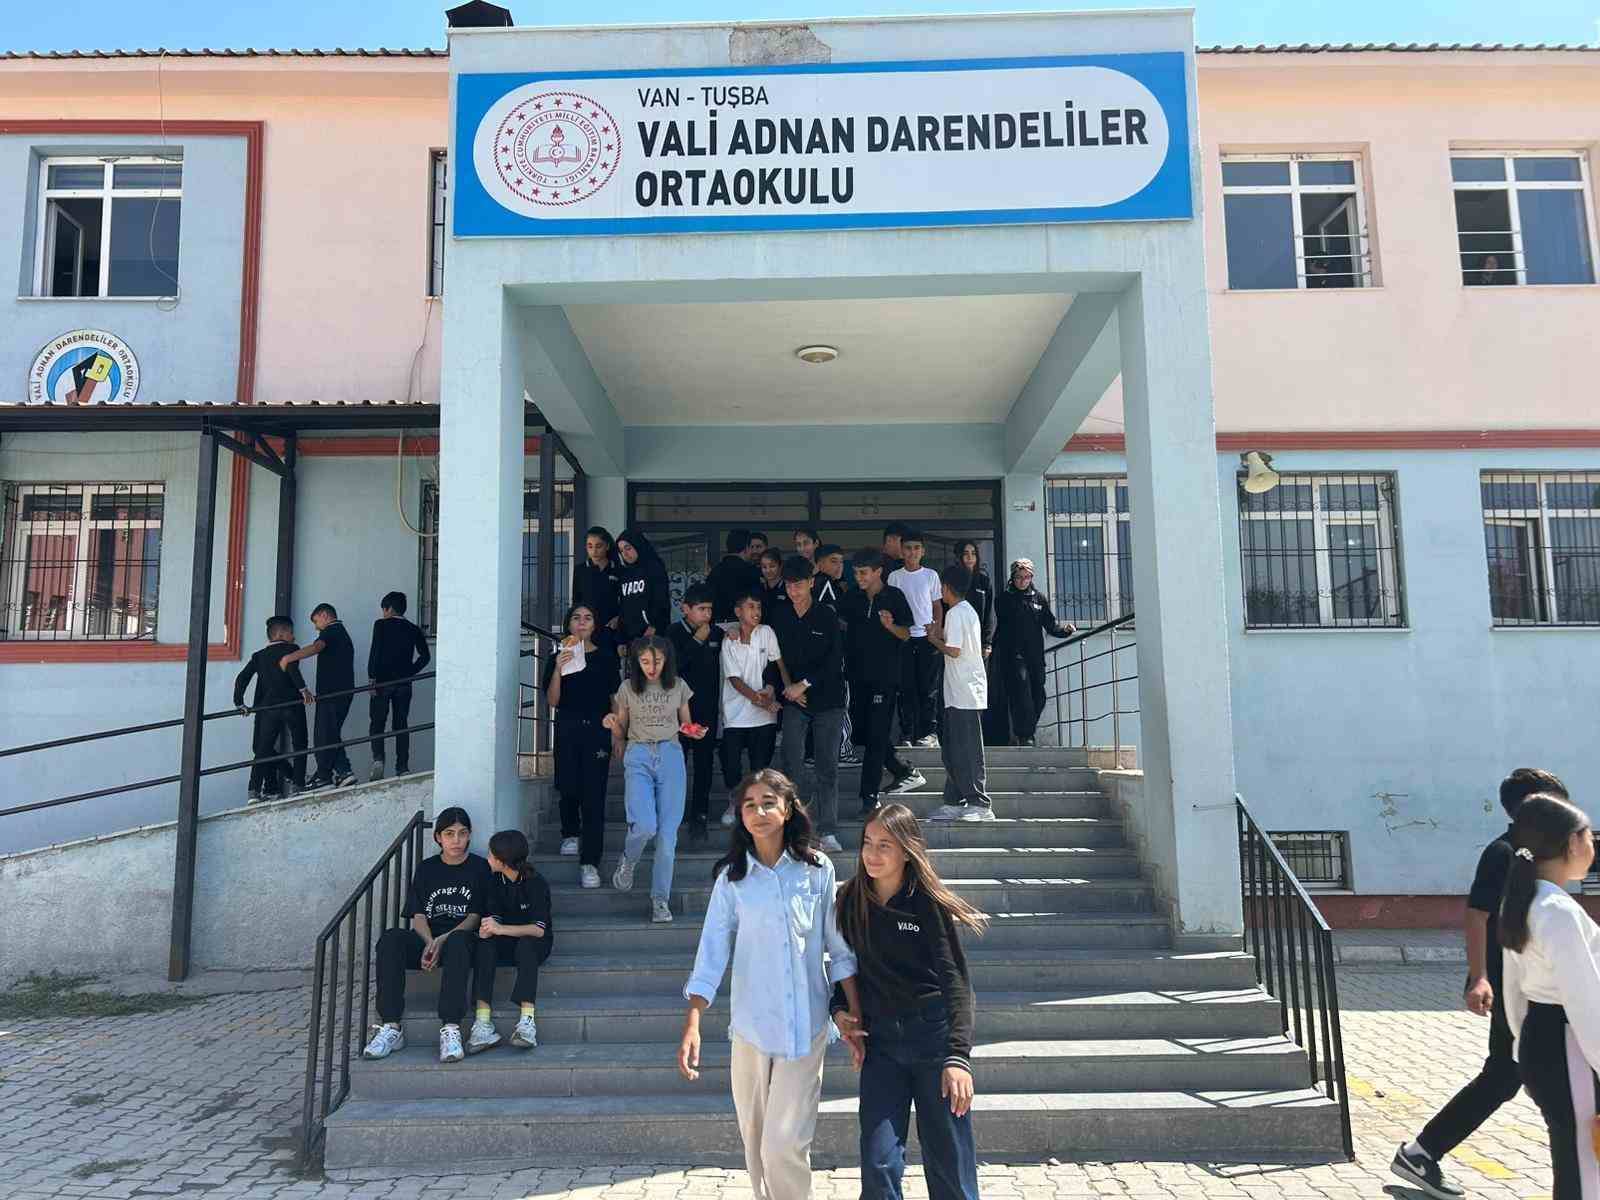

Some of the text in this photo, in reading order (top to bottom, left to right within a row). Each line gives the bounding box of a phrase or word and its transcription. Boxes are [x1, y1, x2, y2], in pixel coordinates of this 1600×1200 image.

[637, 87, 680, 107] VAN
[700, 86, 769, 109] TUŞBA
[637, 100, 1149, 157] VALİ ADNAN DARENDELİLER
[635, 167, 854, 207] ORTAOKULU
[36, 351, 55, 378] ADNAN
[55, 334, 118, 350] DARENDELİLER
[119, 349, 134, 398] ORTAOKULU
[622, 580, 645, 596] VADO
[897, 921, 920, 932] VADO
